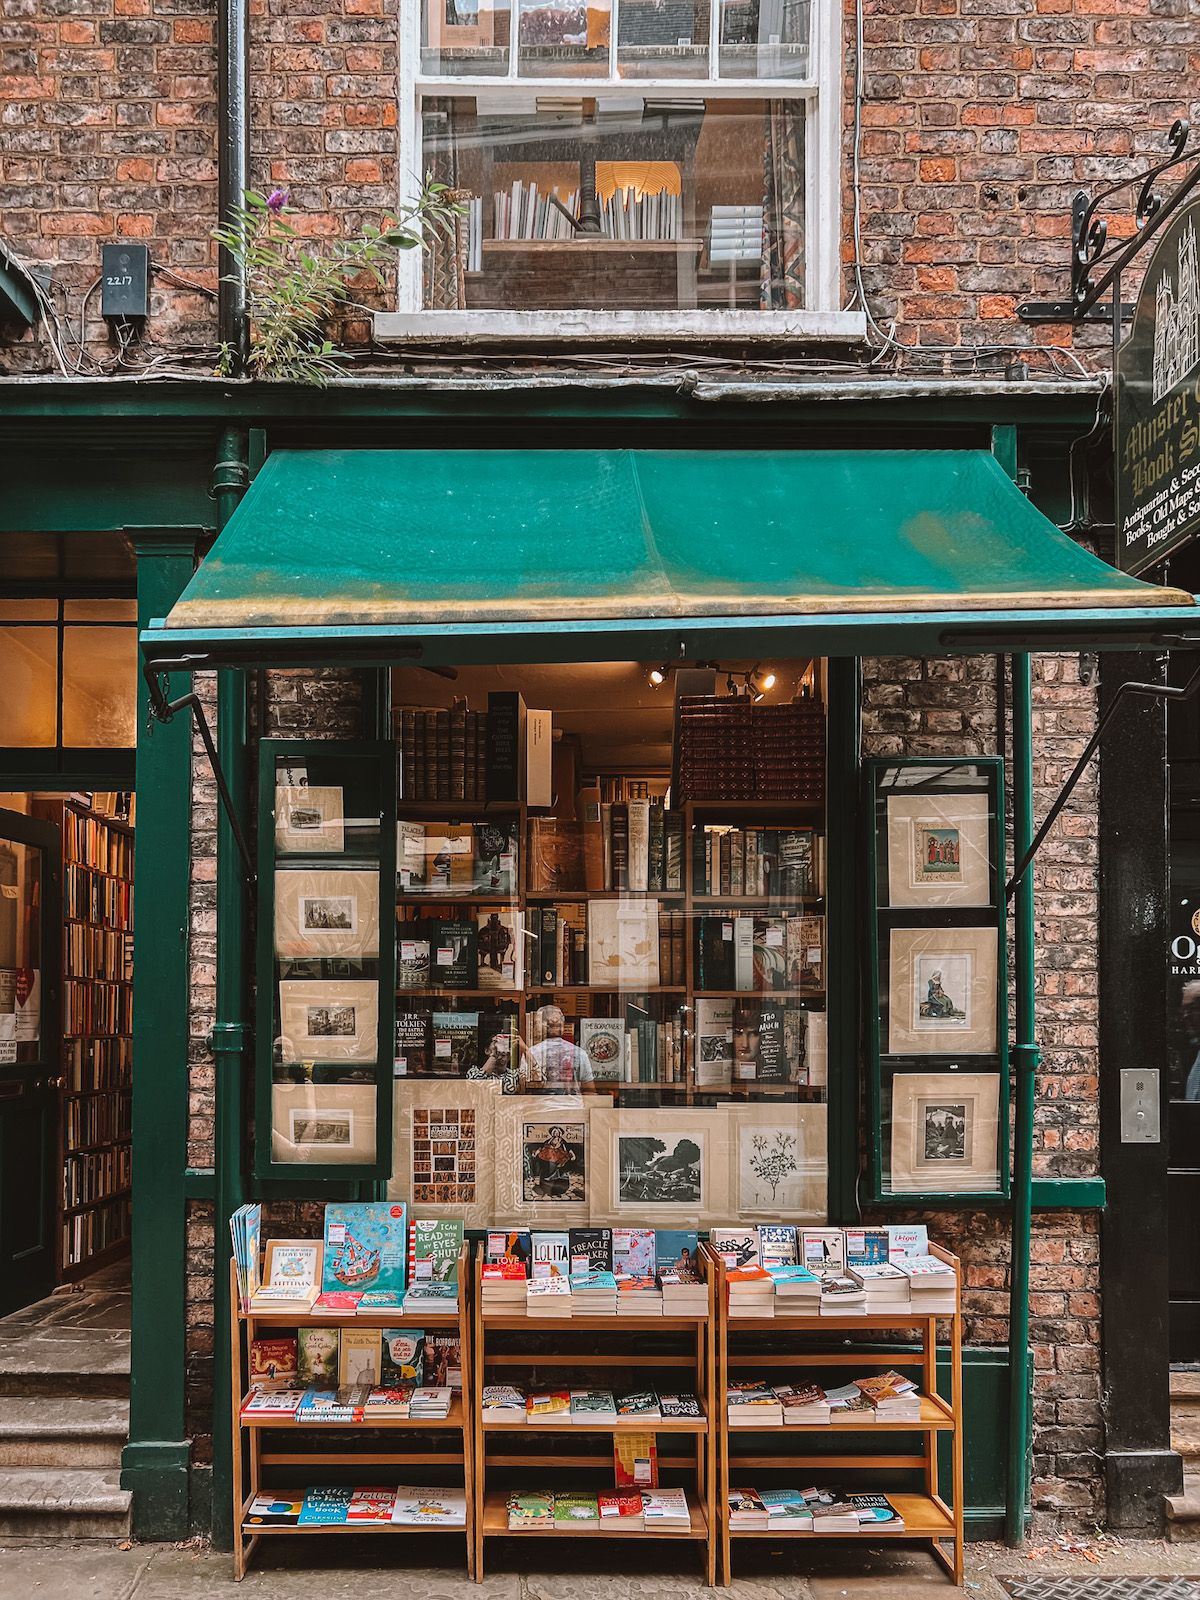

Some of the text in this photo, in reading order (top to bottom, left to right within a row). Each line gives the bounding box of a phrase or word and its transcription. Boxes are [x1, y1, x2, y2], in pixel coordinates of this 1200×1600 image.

[106, 276, 132, 286] 2217
[1123, 388, 1190, 470] Minster
[1131, 438, 1174, 502] Book
[1123, 489, 1169, 532] Antiquarian
[1170, 477, 1181, 494] &
[1125, 520, 1152, 547] Books,
[1152, 501, 1168, 525] Old
[1169, 488, 1194, 515] Maps
[1146, 518, 1176, 549] Bought
[1176, 509, 1188, 526] &
[396, 1020, 427, 1028] TOLKIEN
[758, 1022, 779, 1032] MUCH
[526, 1125, 536, 1138] F
[418, 1232, 443, 1242] READ
[433, 1238, 456, 1250] EYES
[571, 1240, 609, 1254] TREACLE
[433, 1247, 461, 1259] SHUT!
[534, 1245, 569, 1261] LOLITA
[497, 1257, 520, 1265] LOVE
[425, 1335, 460, 1346] THE BORROWE
[313, 1488, 349, 1496] Little
[307, 1501, 350, 1509] Library
